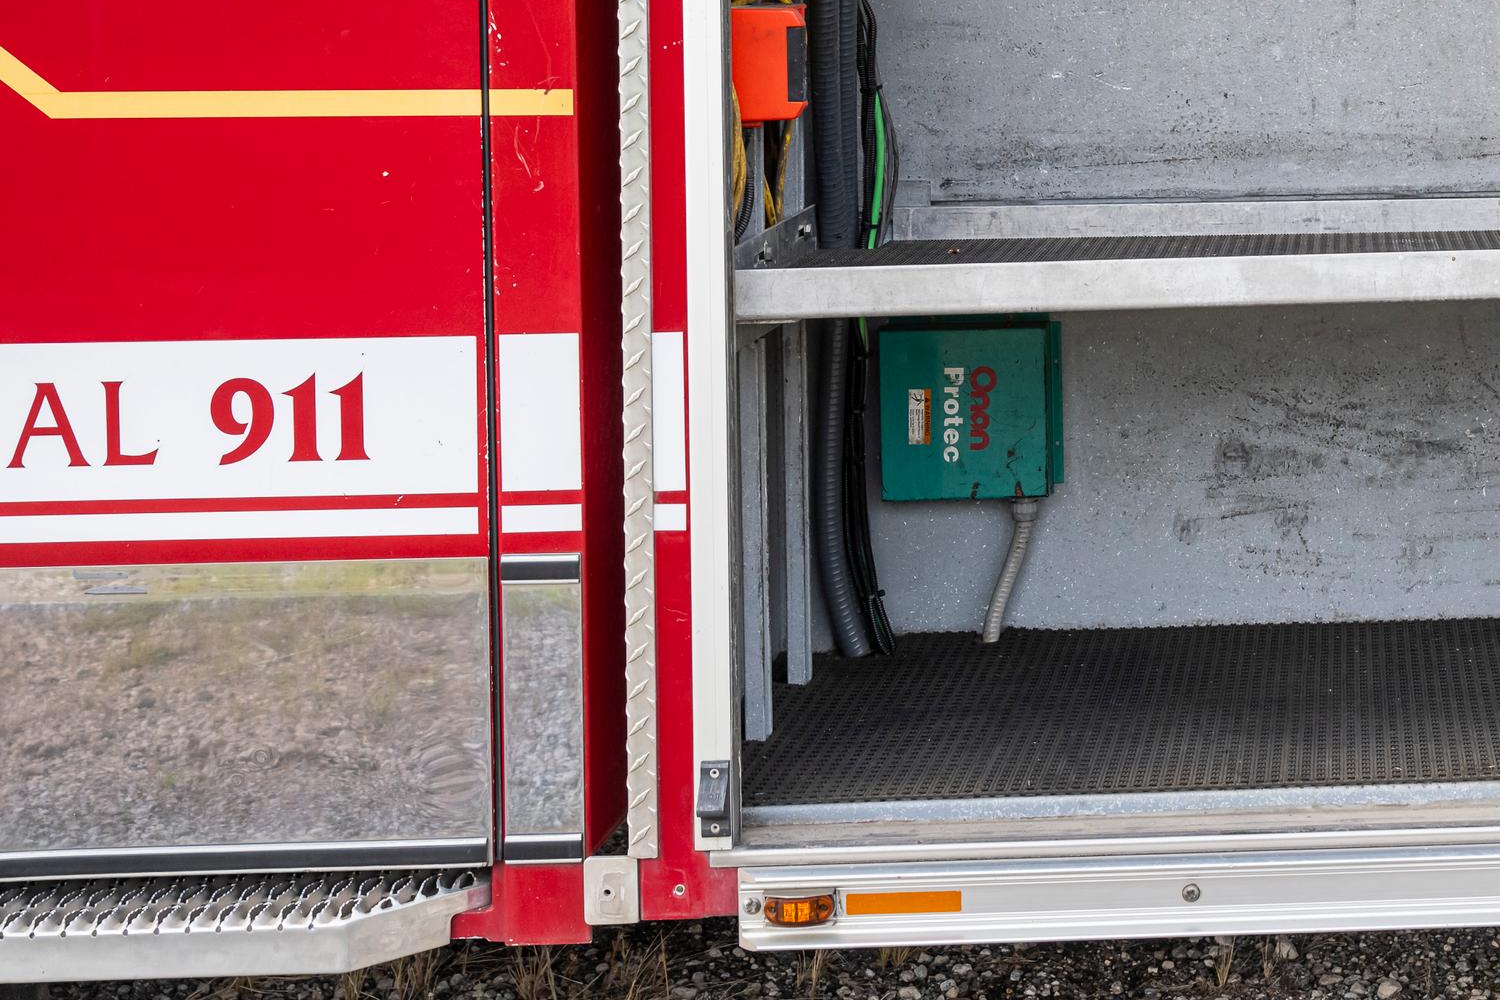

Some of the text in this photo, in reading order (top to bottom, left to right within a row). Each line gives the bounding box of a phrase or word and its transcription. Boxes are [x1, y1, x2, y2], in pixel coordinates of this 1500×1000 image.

[210, 370, 371, 466] 911
[943, 367, 965, 463] Protec
[969, 365, 997, 451] Onan
